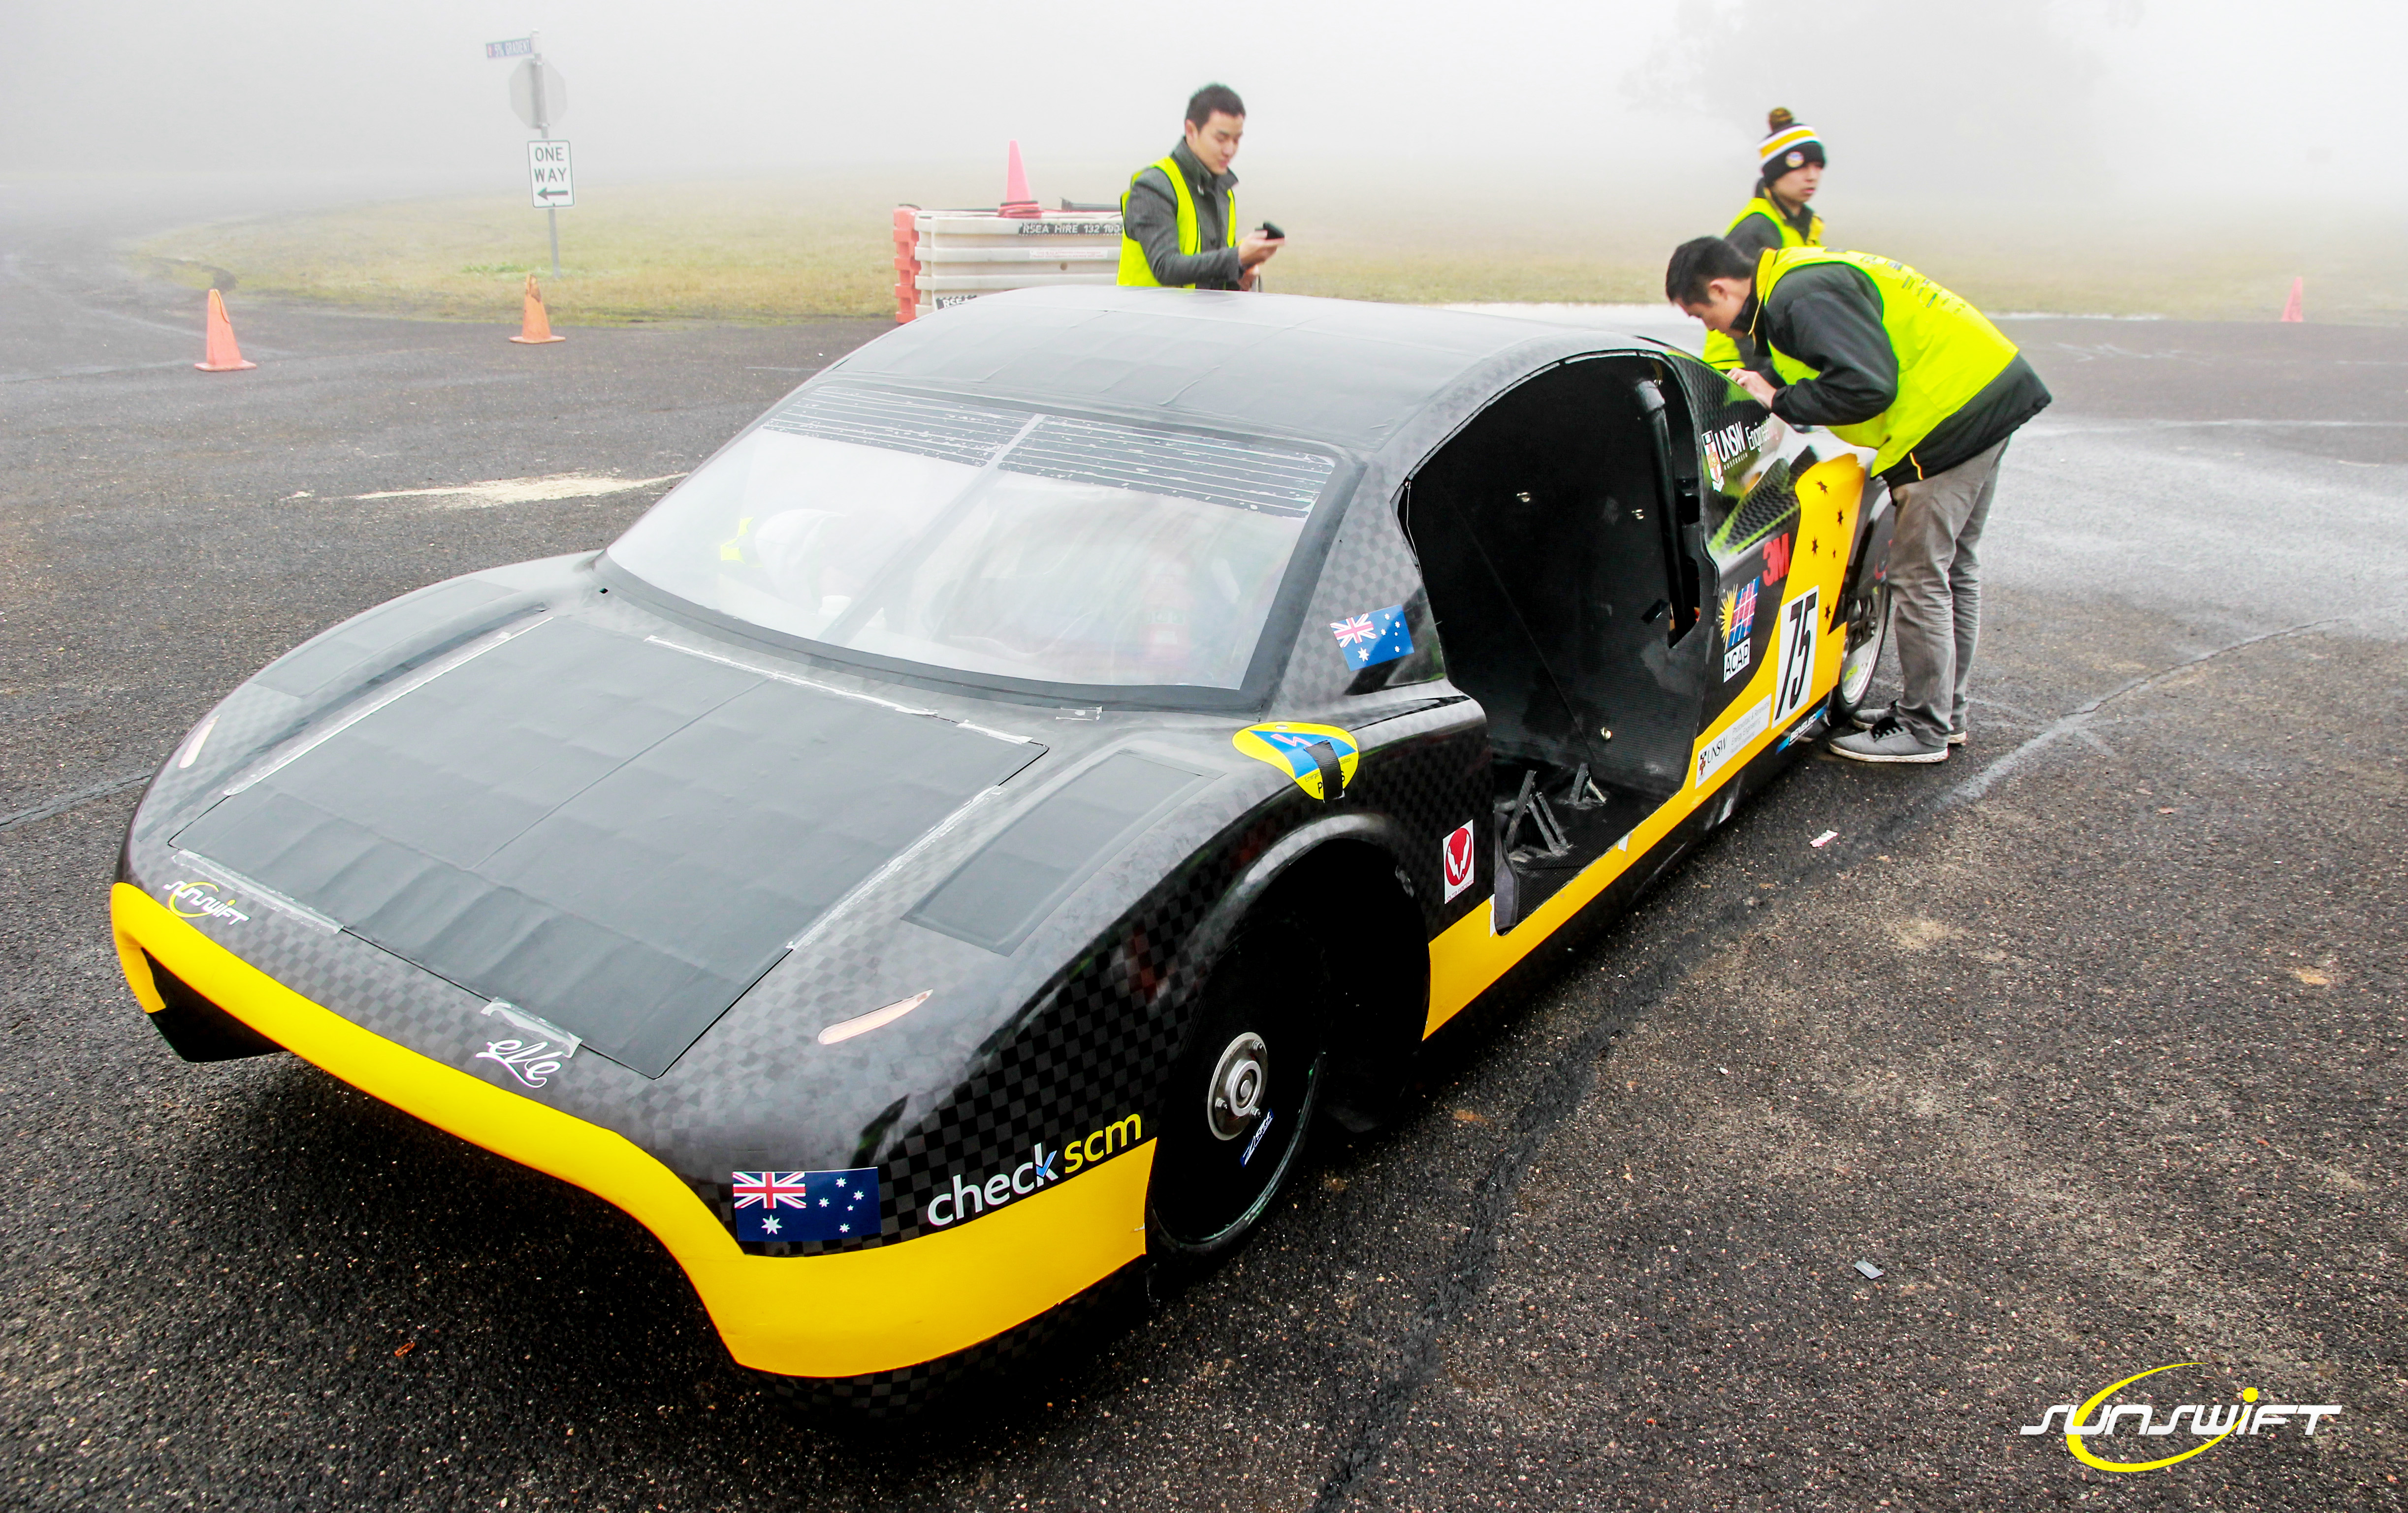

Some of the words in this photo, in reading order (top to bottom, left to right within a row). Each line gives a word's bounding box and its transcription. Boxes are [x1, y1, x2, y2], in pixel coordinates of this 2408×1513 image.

[535, 147, 564, 162] ONE
[534, 167, 567, 183] WAY
[1023, 224, 1049, 234] RSEA
[1054, 224, 1078, 233] HIRE
[1084, 224, 1100, 233] 132
[942, 297, 969, 309] RSE
[1714, 421, 1746, 463] UNSW
[1744, 415, 1779, 453] Enginee
[1763, 533, 1789, 586] 3M
[1725, 644, 1749, 678] ACAP
[1774, 591, 1817, 721] 75
[1707, 735, 1728, 763] UNSW
[927, 1142, 1059, 1226] check
[1064, 1113, 1141, 1173] scm
